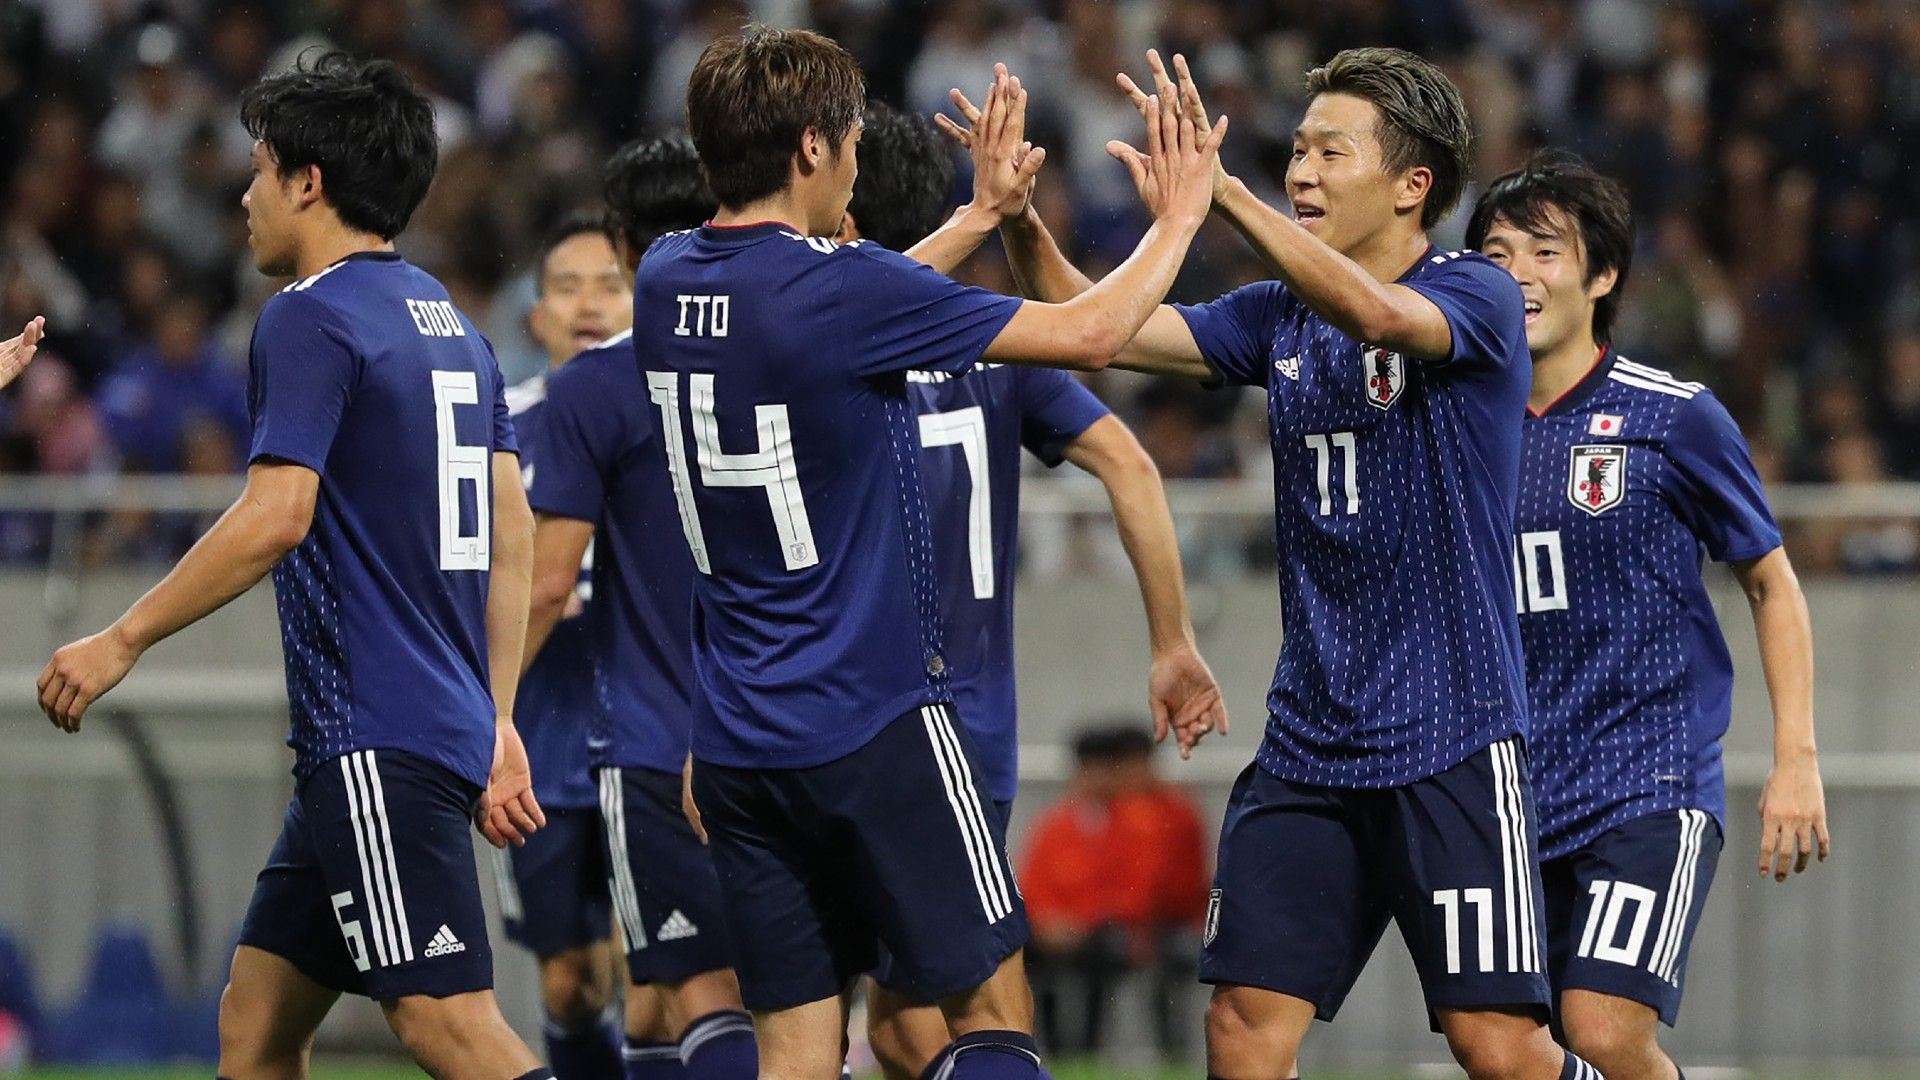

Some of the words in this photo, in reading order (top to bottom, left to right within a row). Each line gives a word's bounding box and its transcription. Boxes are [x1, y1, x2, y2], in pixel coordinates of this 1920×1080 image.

[405, 298, 466, 338] ENDO
[674, 294, 730, 337] ITO
[1275, 360, 1299, 381] adid
[431, 370, 490, 571] 6
[646, 371, 820, 575] 14
[1304, 431, 1360, 516] 11
[1583, 447, 1613, 455] JAPAN
[917, 405, 995, 600] 7
[1584, 491, 1607, 502] JFA
[330, 890, 371, 972] 6
[424, 941, 466, 958] adidas
[1433, 887, 1495, 974] 11
[1577, 879, 1657, 967] 10
